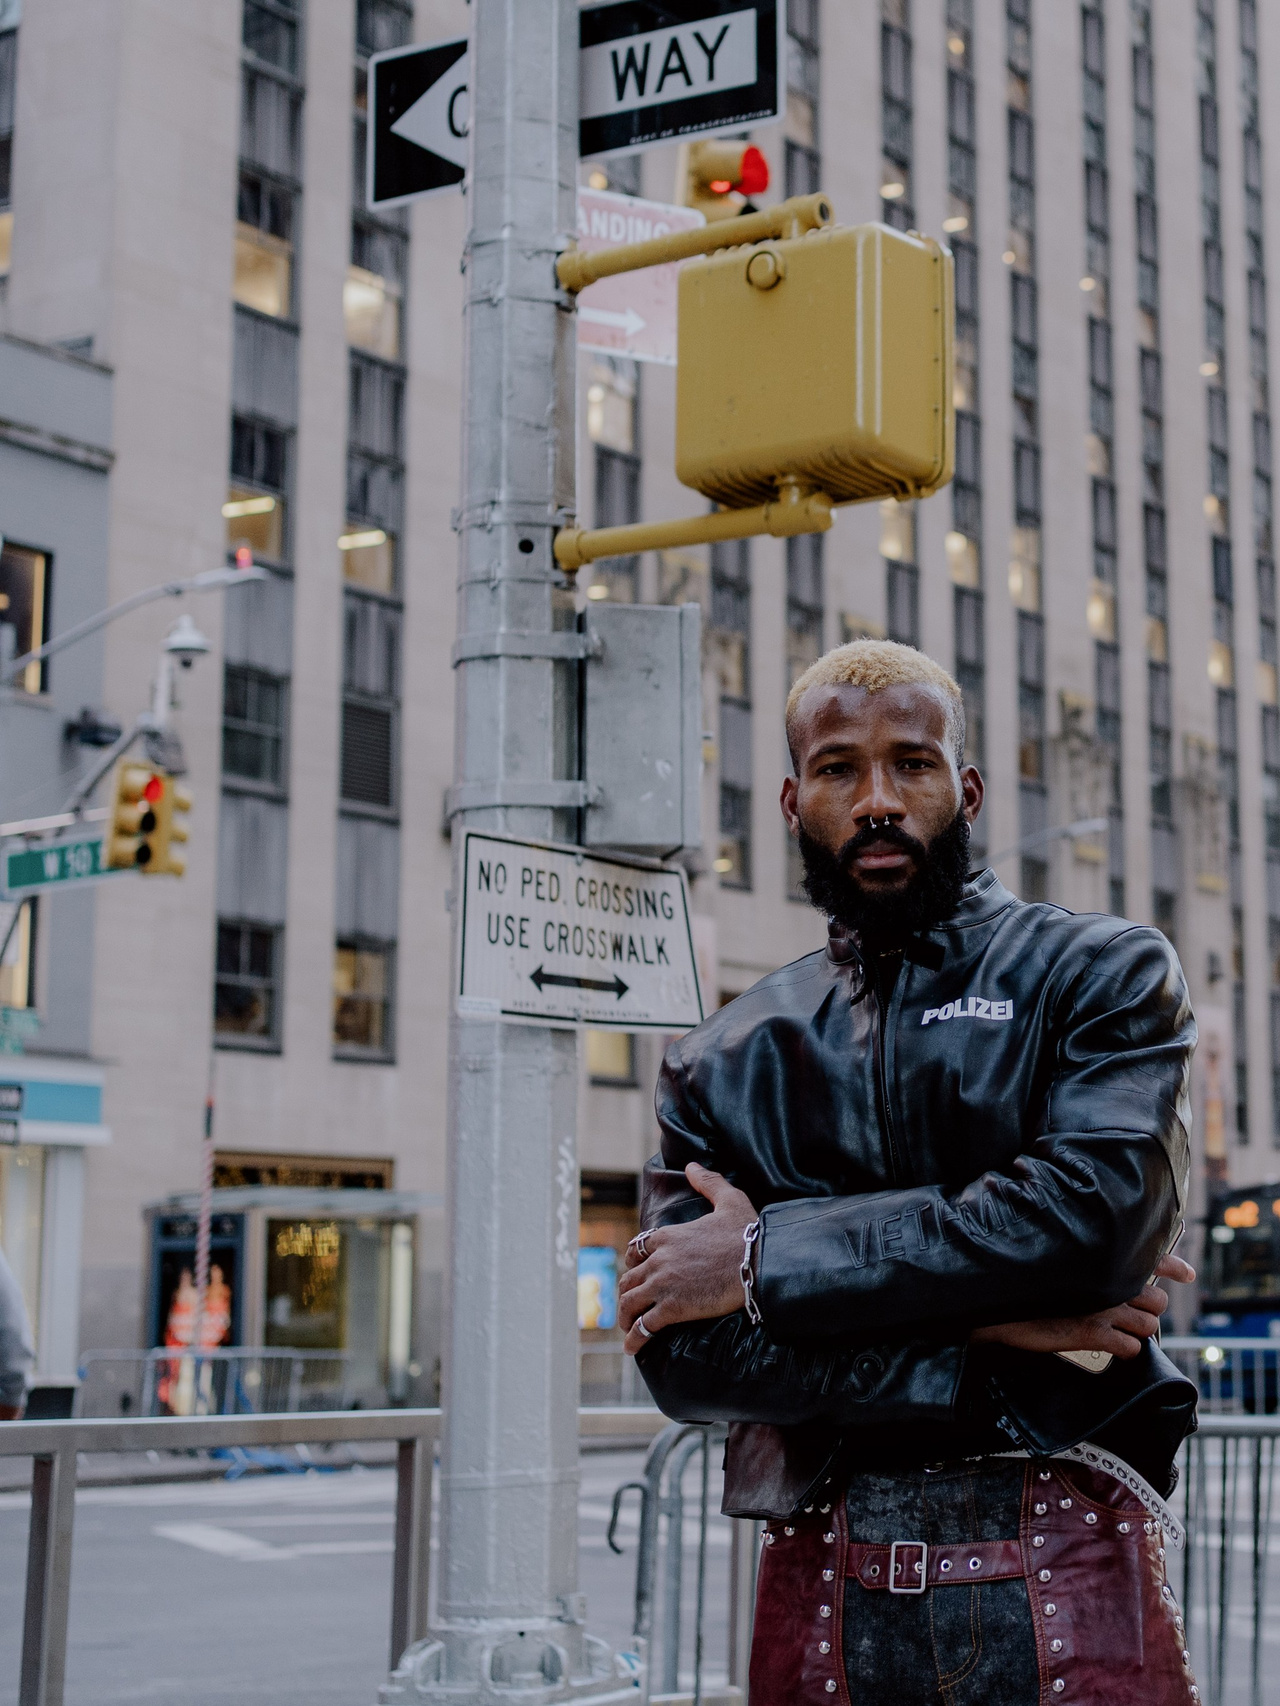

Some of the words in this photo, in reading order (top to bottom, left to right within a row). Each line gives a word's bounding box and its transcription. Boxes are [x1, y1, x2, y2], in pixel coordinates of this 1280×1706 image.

[610, 23, 730, 102] WAY
[478, 860, 508, 895] NO
[575, 876, 674, 920] CROSSING
[487, 912, 530, 949] USE
[543, 921, 671, 966] CROSSWALK
[921, 997, 1014, 1026] POLIZEI
